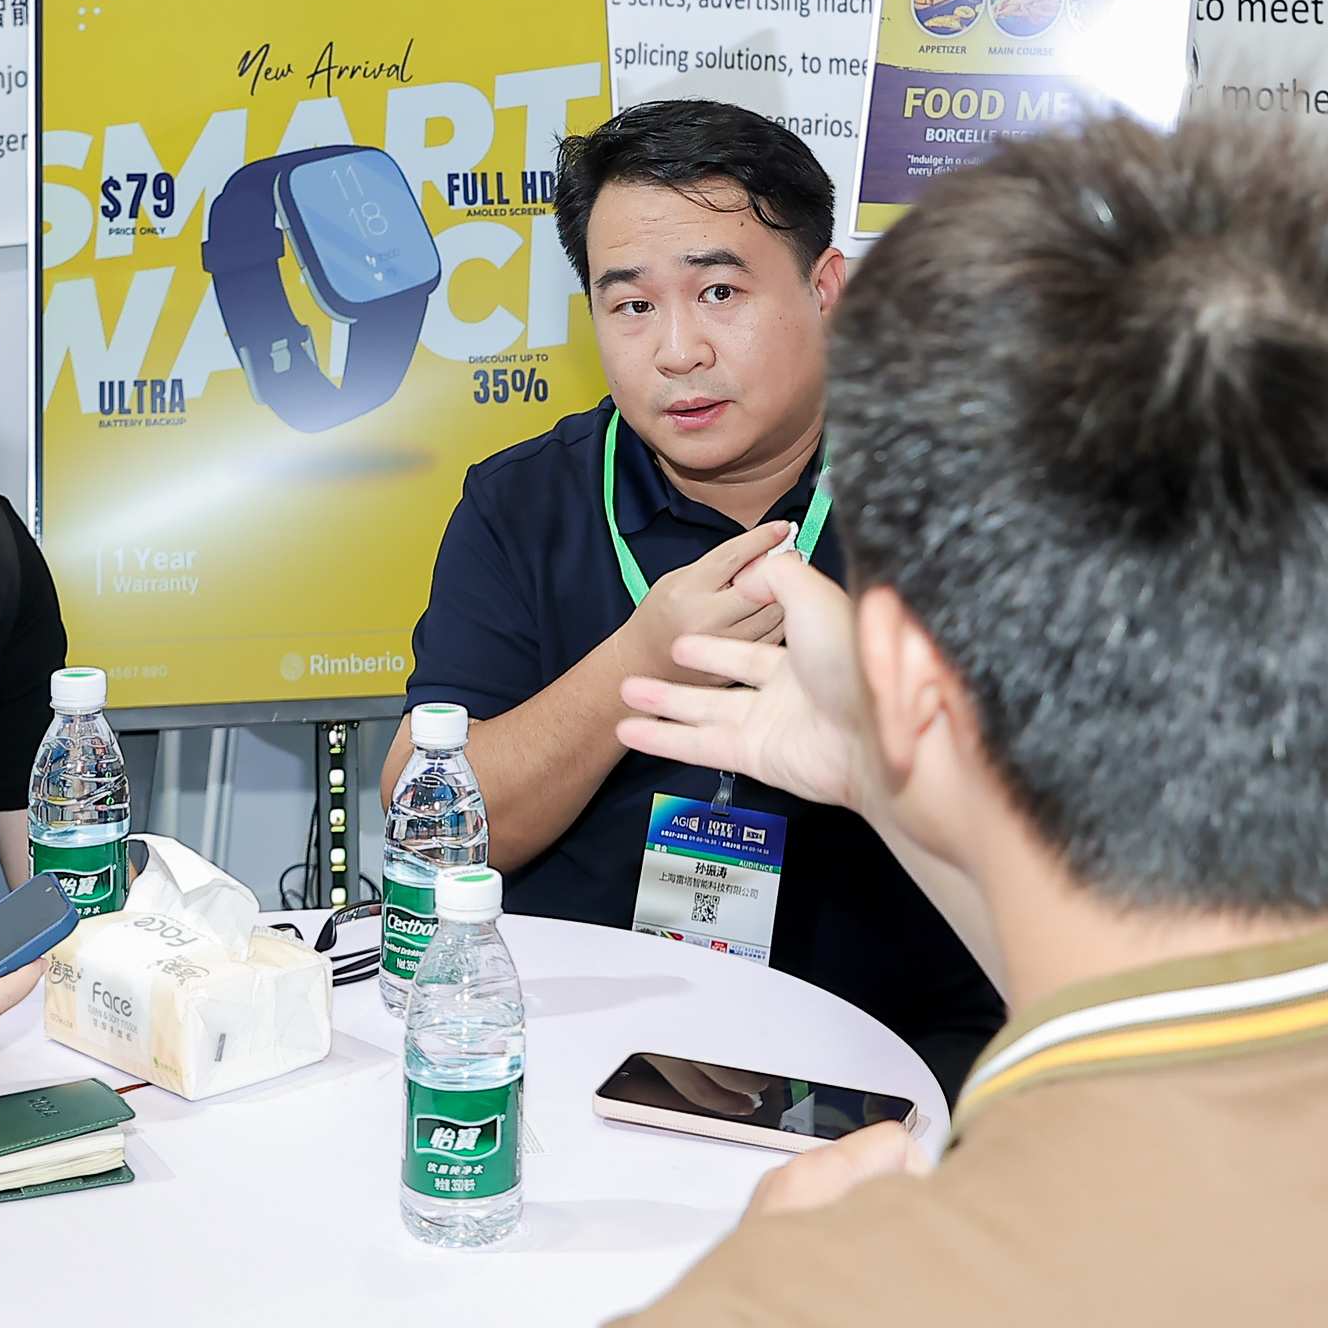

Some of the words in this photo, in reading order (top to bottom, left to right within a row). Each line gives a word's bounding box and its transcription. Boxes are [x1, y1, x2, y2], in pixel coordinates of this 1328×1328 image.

[615, 44, 688, 74] splicing
[695, 47, 793, 74] solutions,
[801, 52, 821, 74] to
[919, 45, 966, 54] APPETIZER
[988, 47, 1013, 56] MAIN
[237, 41, 293, 95] New
[306, 39, 414, 97] Arrival
[903, 87, 1005, 120] FOOD
[41, 63, 602, 269] SMART
[101, 171, 174, 222] $79
[448, 171, 511, 206] FULL
[523, 171, 554, 204] HD
[466, 208, 507, 217] AMOLED
[509, 208, 546, 217] SCREEN
[139, 227, 166, 235] ONLY
[468, 353, 517, 364] DISCOUNT
[520, 353, 532, 364] UP
[535, 353, 549, 364] TO
[98, 378, 185, 416] ULTRA
[473, 368, 548, 404] 35%
[98, 418, 143, 428] BATTERY
[145, 418, 185, 428] BACKUP
[134, 548, 197, 570] Year
[113, 576, 199, 594] Warranty
[310, 652, 404, 675] Rimberio
[739, 860, 773, 872] AUDIENCE
[92, 982, 132, 1017] Face
